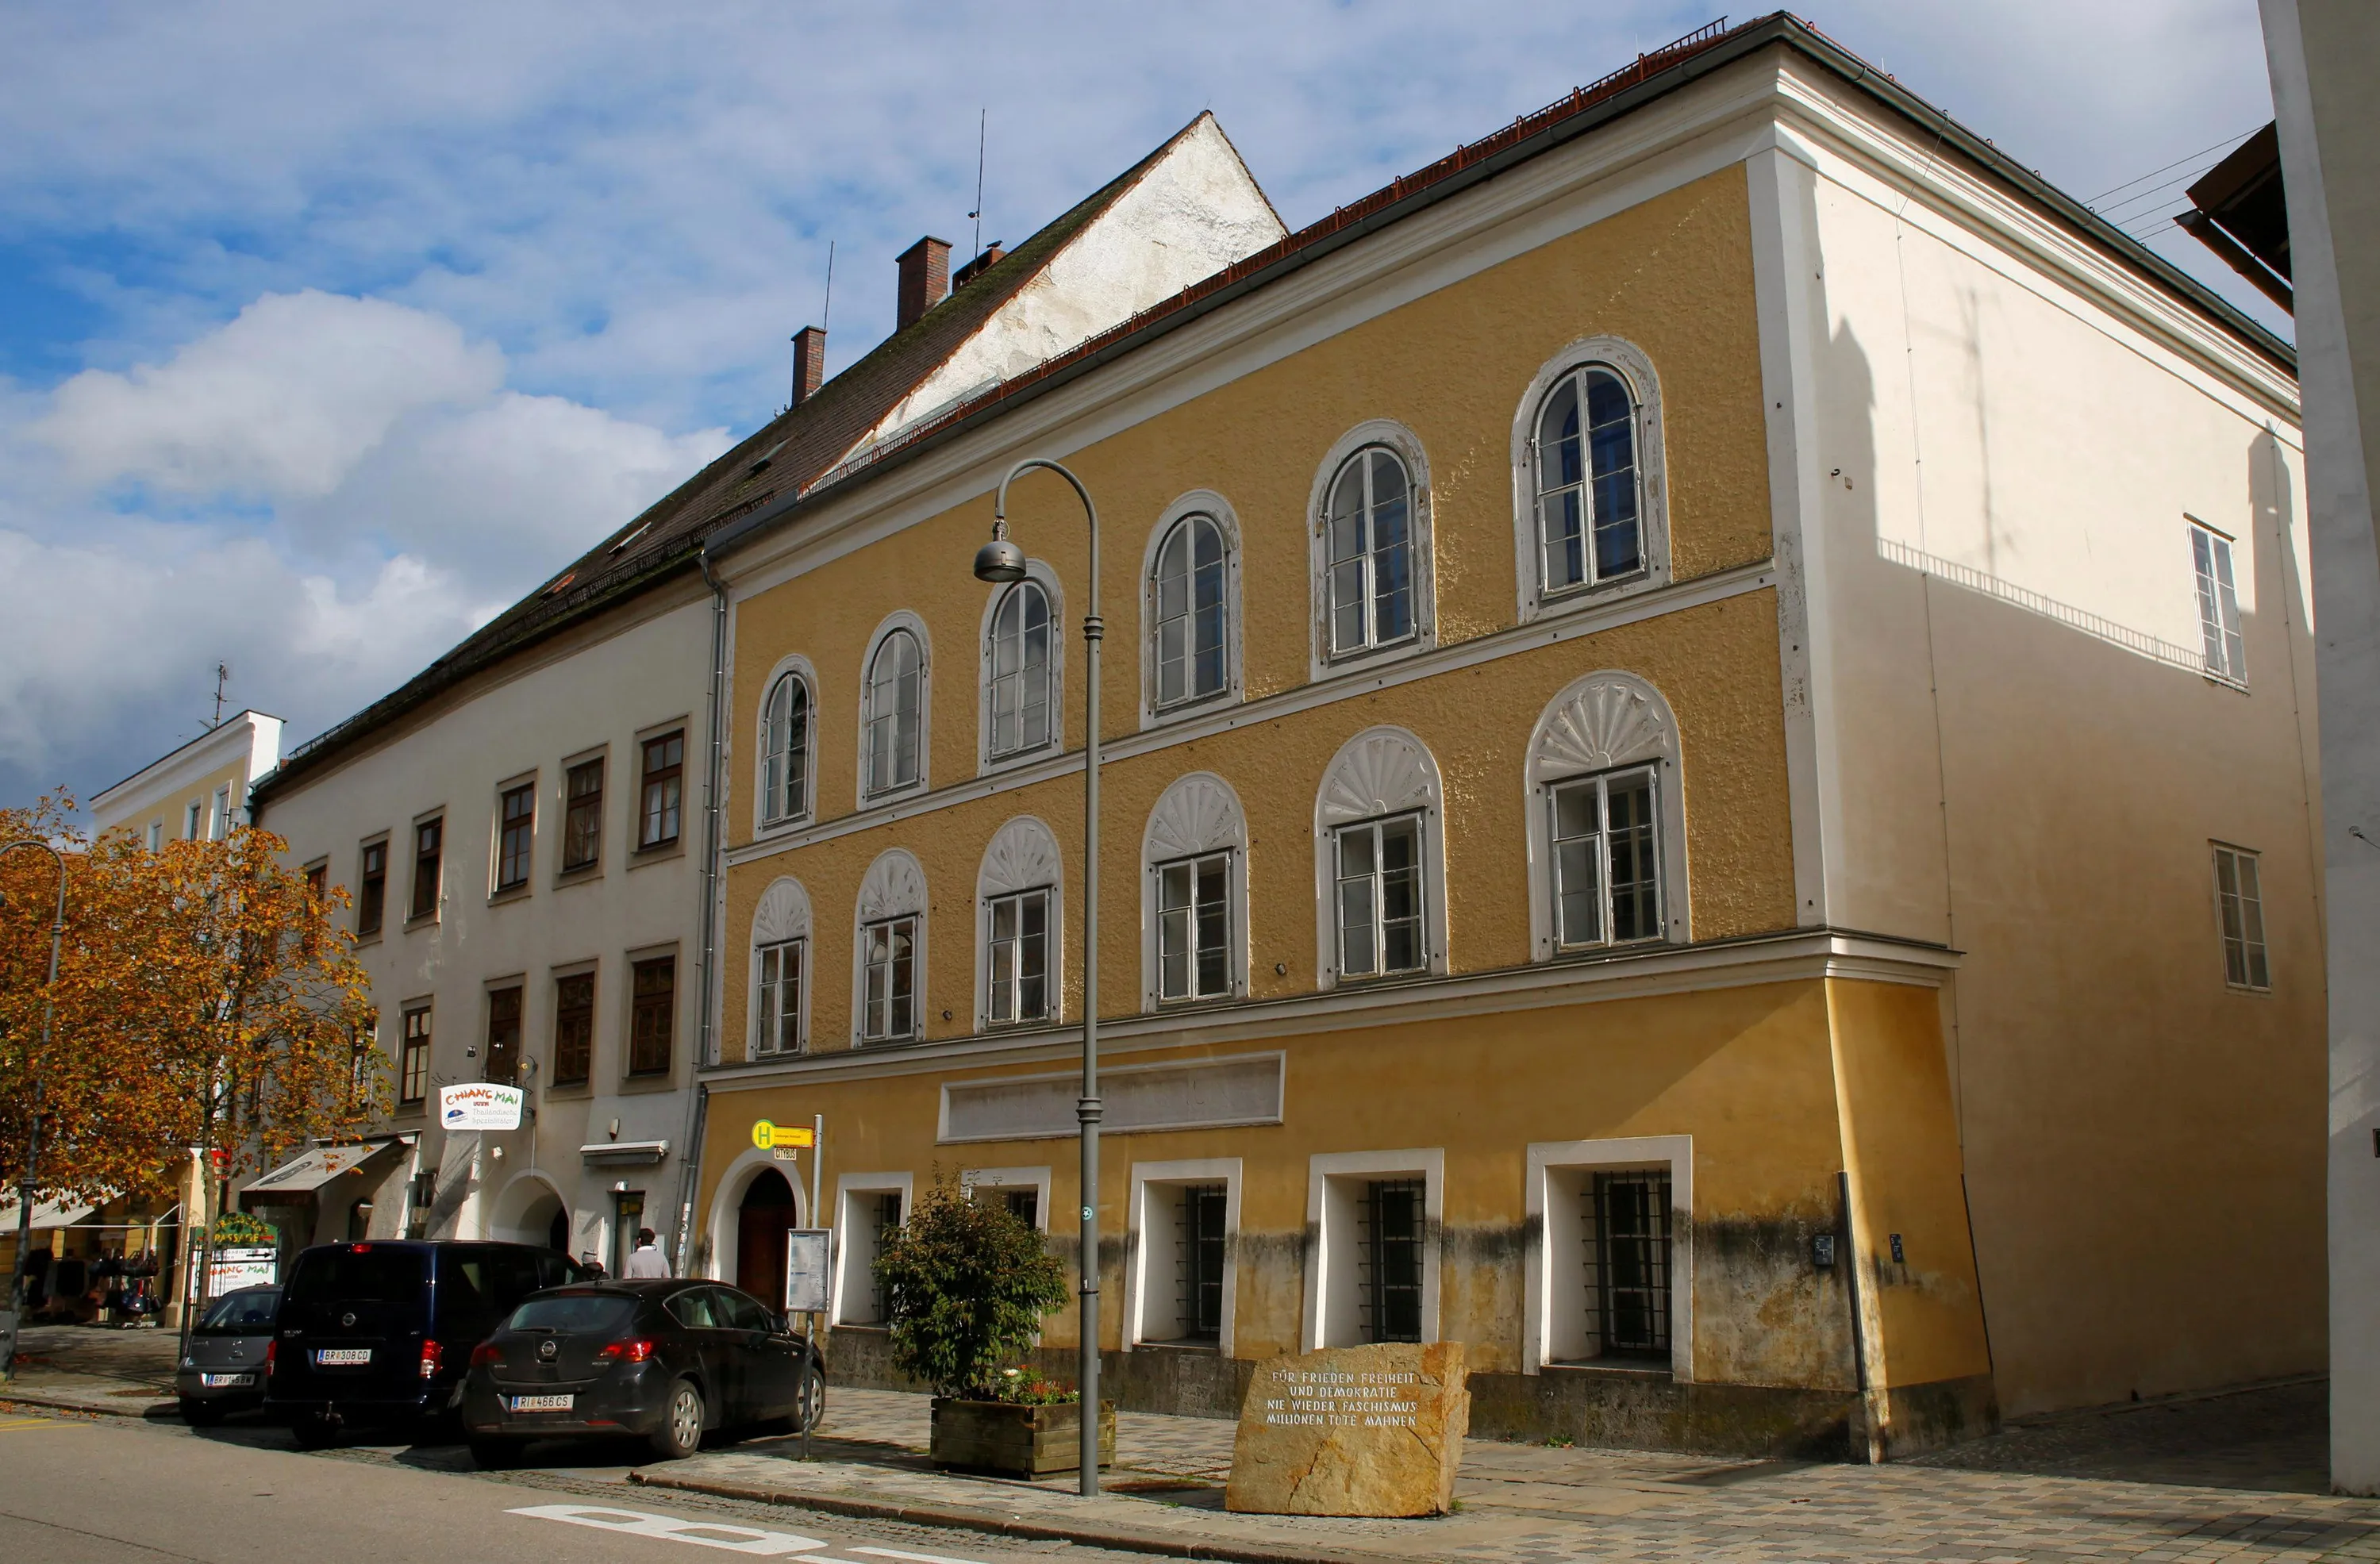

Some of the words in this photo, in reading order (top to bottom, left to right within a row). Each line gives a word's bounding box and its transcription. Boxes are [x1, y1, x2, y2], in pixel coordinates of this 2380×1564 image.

[446, 1088, 493, 1105] CHIANG
[494, 1090, 518, 1105] MAI
[759, 1125, 771, 1145] H
[775, 1148, 795, 1159] CITYBUS
[247, 1265, 270, 1274] MAI
[325, 1351, 336, 1360] BR
[340, 1351, 356, 1360] 308
[358, 1351, 368, 1360] CD
[214, 1375, 224, 1384] BR
[1272, 1370, 1295, 1382] FÜR
[1302, 1372, 1354, 1384] FRIEDEN
[1361, 1372, 1415, 1384] FREIHEIT
[1290, 1385, 1313, 1397] UND
[1320, 1386, 1397, 1398] DEMOKRATIE
[521, 1397, 530, 1407] RI
[536, 1397, 554, 1407] 466
[556, 1397, 568, 1407] CS
[1267, 1400, 1285, 1410] NIE
[1291, 1400, 1336, 1412] WIEDER
[1343, 1401, 1417, 1412] FASCHISMUS
[1266, 1414, 1324, 1425] MILLIONEN
[1328, 1415, 1357, 1426] TOTE
[1365, 1416, 1417, 1427] MAHNEN
